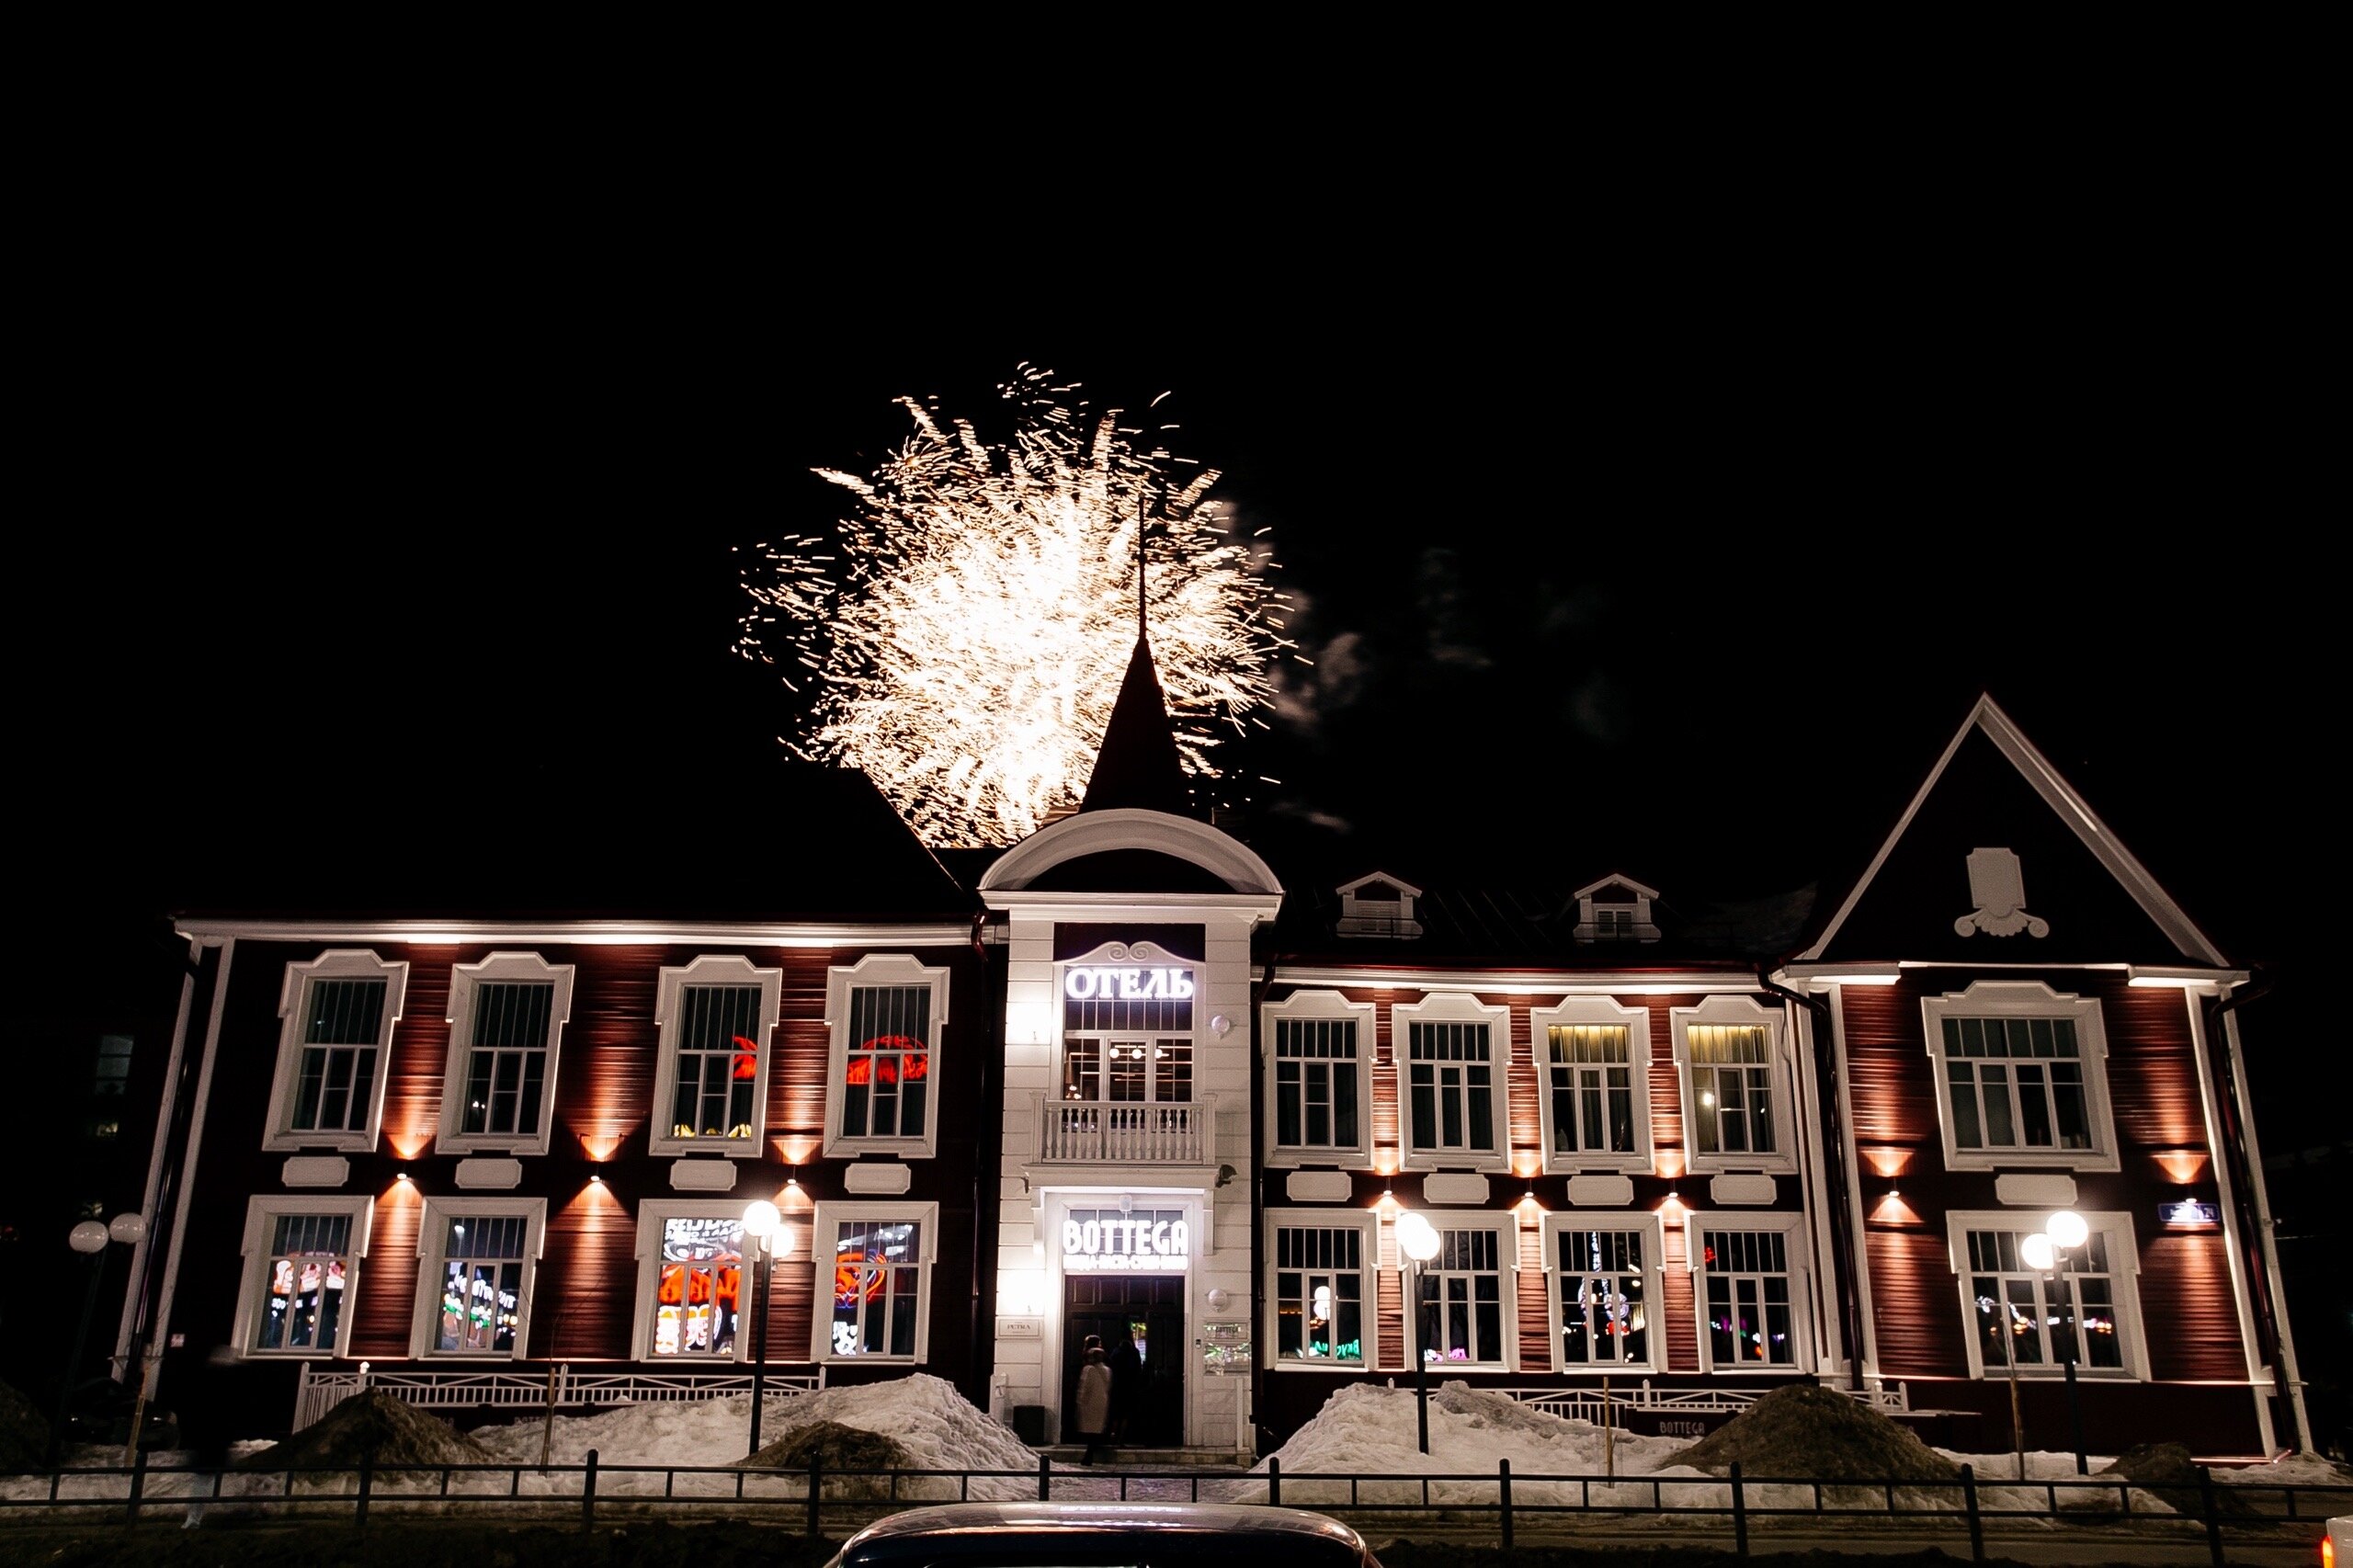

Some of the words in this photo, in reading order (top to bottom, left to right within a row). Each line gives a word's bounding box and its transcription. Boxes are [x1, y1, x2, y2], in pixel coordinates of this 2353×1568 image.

[1065, 968, 1194, 999] ОТЕЛЬ
[1063, 1220, 1189, 1256] BOTTEGA
[1659, 1421, 1705, 1435] BOTTEGA
